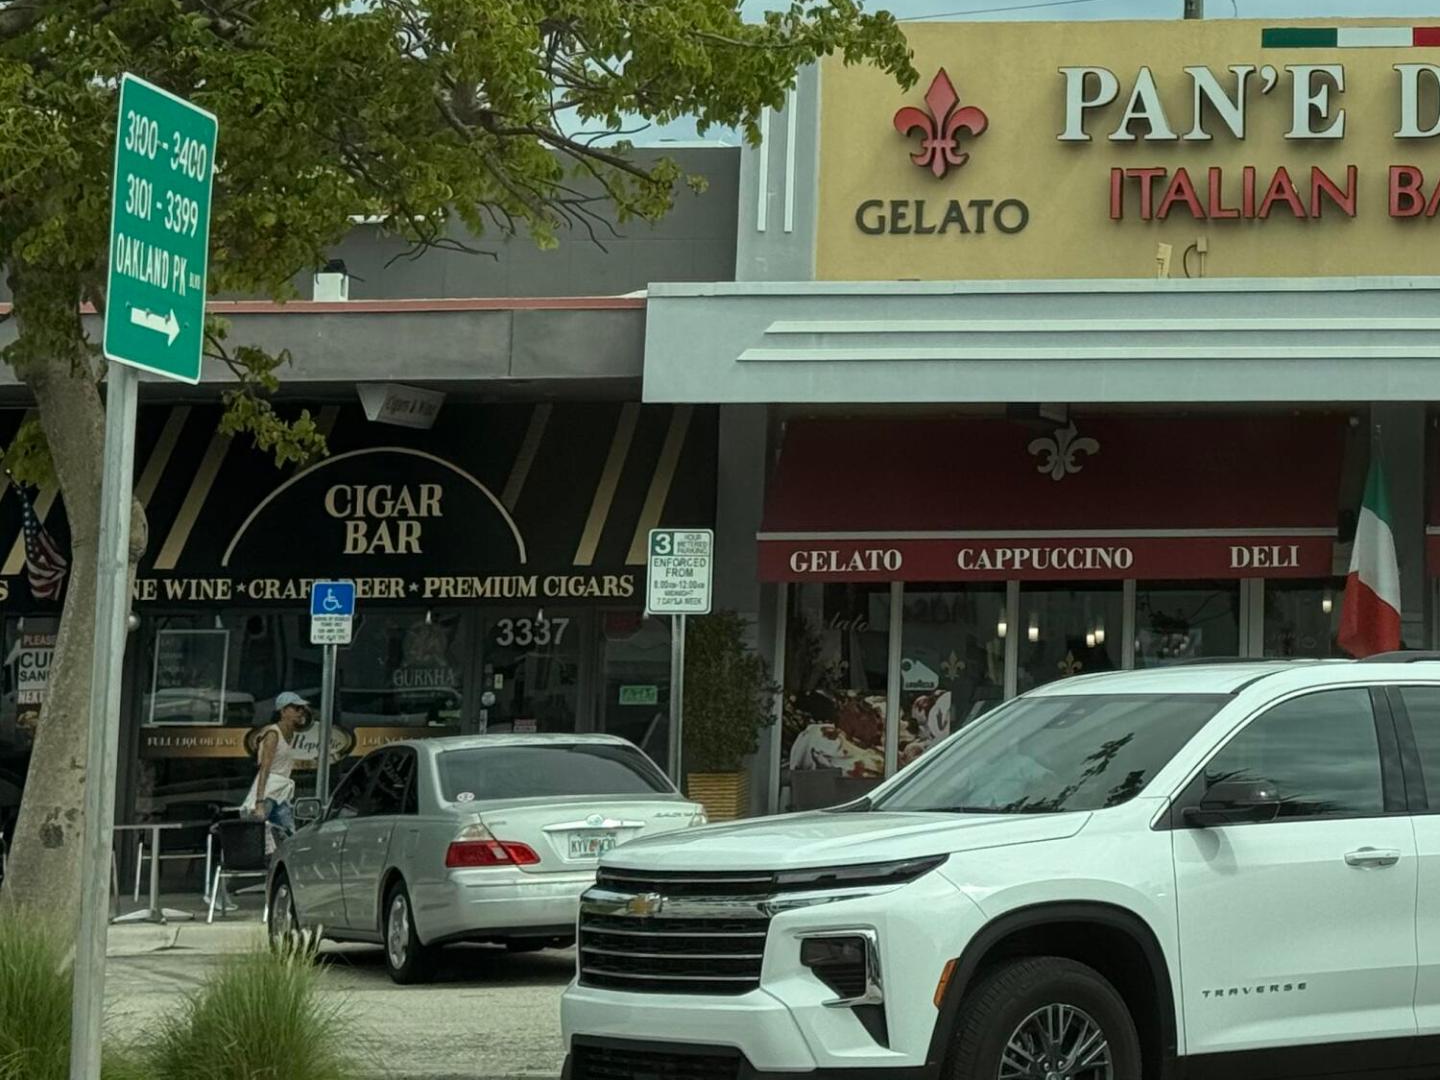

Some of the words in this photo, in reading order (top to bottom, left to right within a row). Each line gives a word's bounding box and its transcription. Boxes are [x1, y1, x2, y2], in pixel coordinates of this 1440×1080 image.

[125, 110, 159, 161] 3100
[171, 131, 207, 183] 3400
[1109, 165, 1357, 221] ITALIAN
[126, 173, 153, 221] 3101
[164, 189, 199, 238] 3399
[855, 199, 1029, 236] GELATO
[116, 232, 169, 290] OAKLAND
[172, 253, 188, 297] PK
[324, 484, 443, 518] CIGAR
[343, 521, 423, 555] BAR
[655, 533, 671, 555] 3
[653, 557, 707, 568] ENFORCED
[790, 550, 902, 573] GELATO
[957, 547, 1133, 570] CAPPUCCINO
[1230, 545, 1299, 568] DELI
[665, 568, 694, 577] FROM
[163, 579, 232, 601] WINE
[249, 578, 329, 601] CRAF
[338, 578, 405, 600] EER
[422, 577, 539, 600] PREMIUM
[544, 575, 635, 599] CIGARS
[496, 618, 569, 646] 3337
[19, 670, 51, 682] SAN
[392, 668, 456, 687] GURKHA
[1201, 982, 1309, 1000] TRAVERSE
